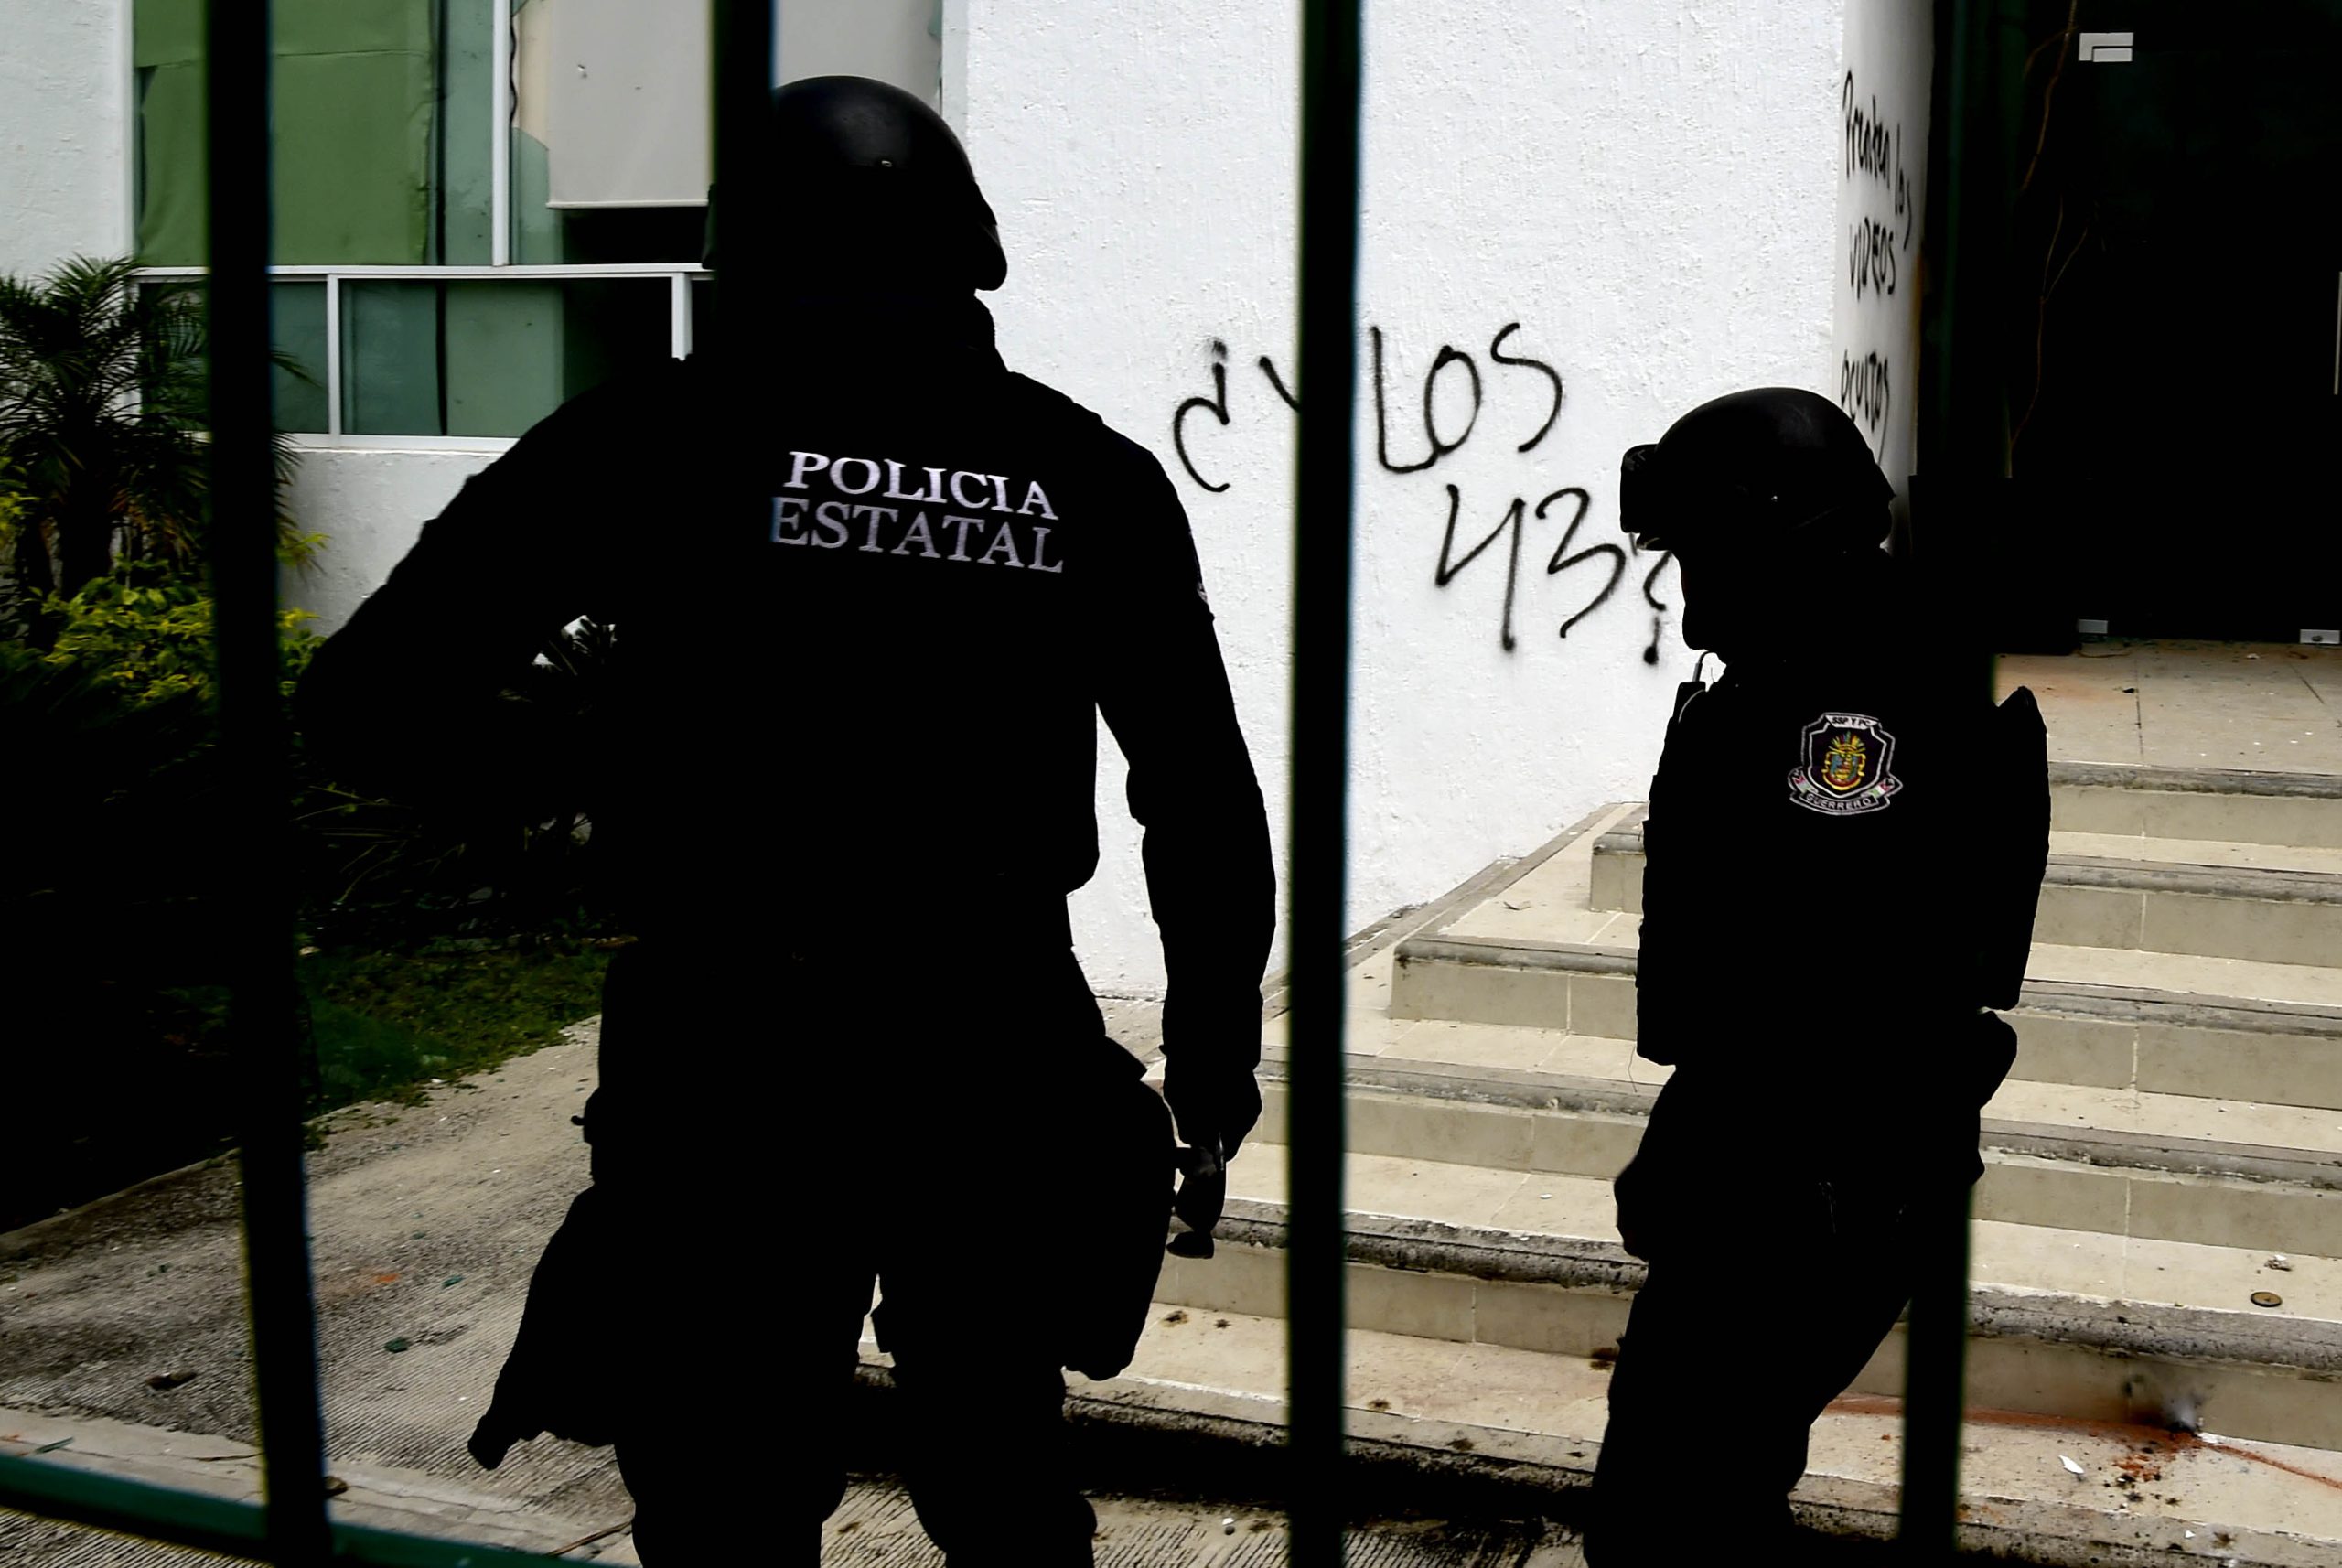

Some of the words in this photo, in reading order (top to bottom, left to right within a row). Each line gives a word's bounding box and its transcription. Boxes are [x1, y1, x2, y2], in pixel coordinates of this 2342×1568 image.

[1369, 322, 1563, 474] LOS
[783, 450, 1059, 521] POLICIA
[769, 496, 1064, 574] ESTATAL
[1806, 793, 1872, 811] GUERRERO
